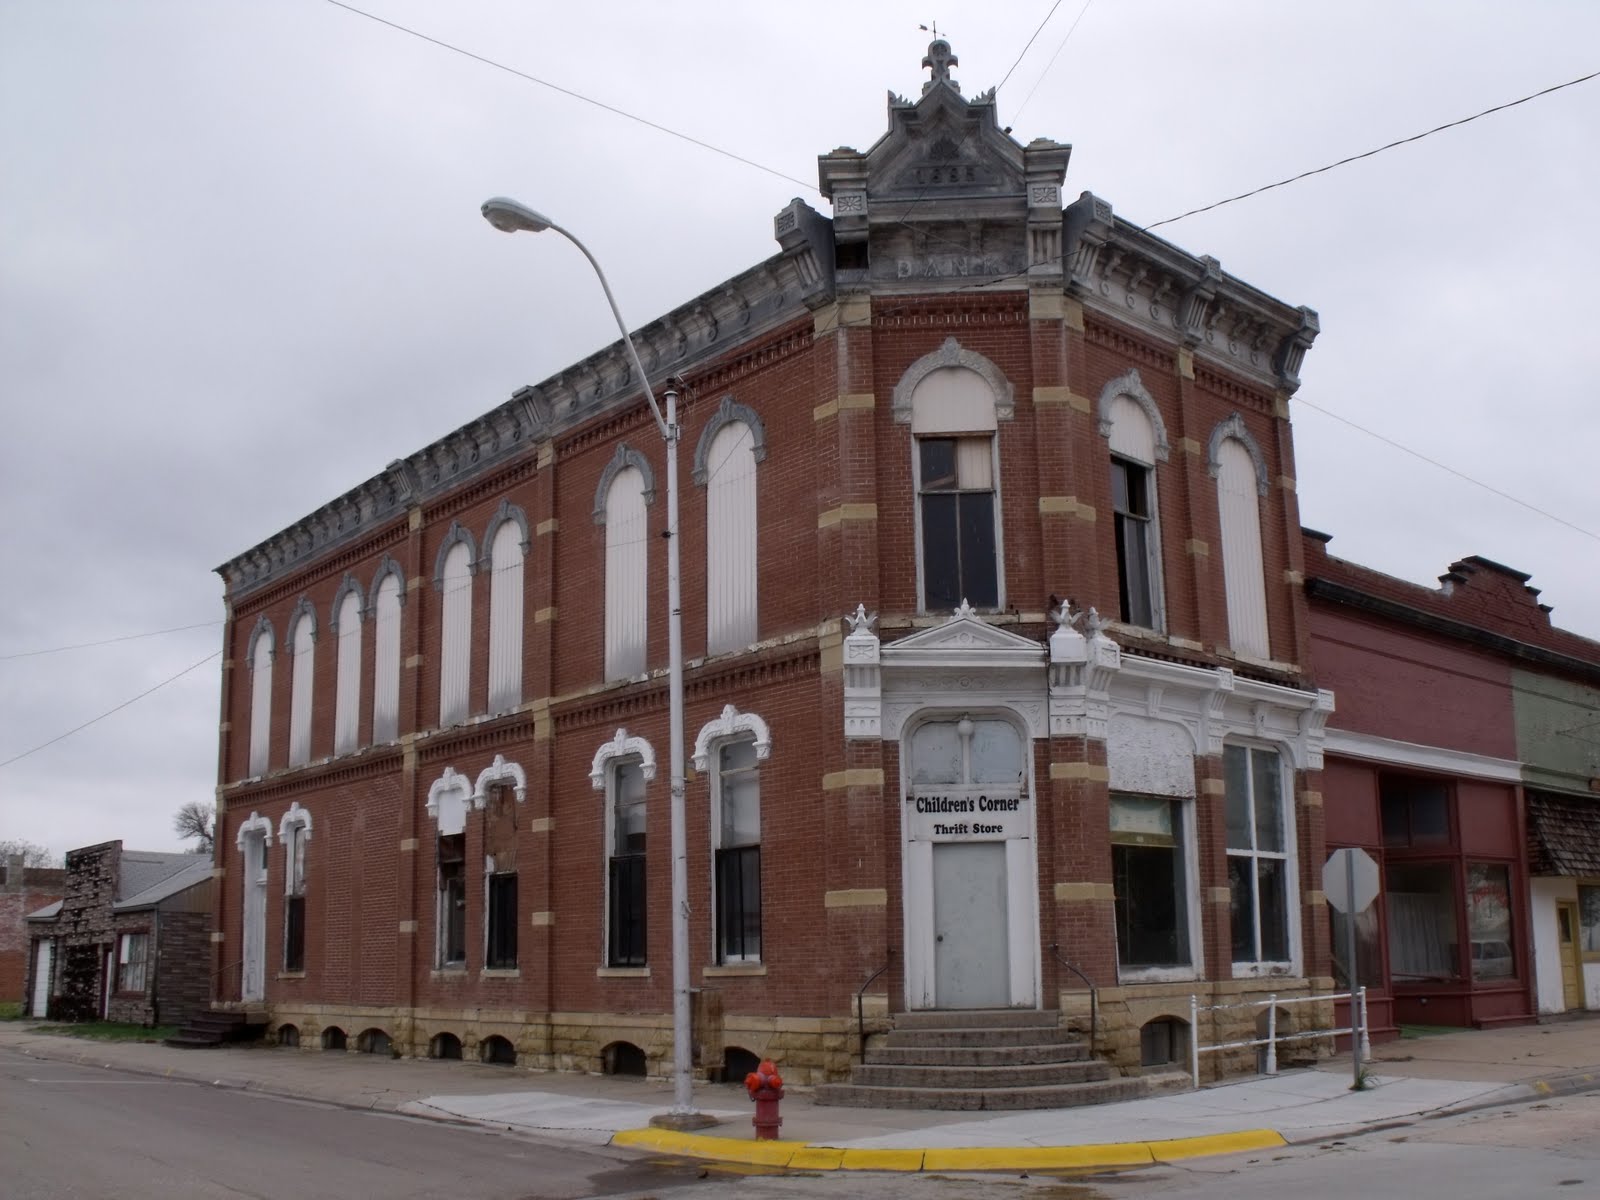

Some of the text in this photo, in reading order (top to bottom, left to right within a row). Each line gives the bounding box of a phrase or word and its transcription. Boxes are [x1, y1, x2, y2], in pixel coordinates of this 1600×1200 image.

[916, 795, 1020, 814] Children's Corner
[933, 823, 1003, 835] Thrift Store
